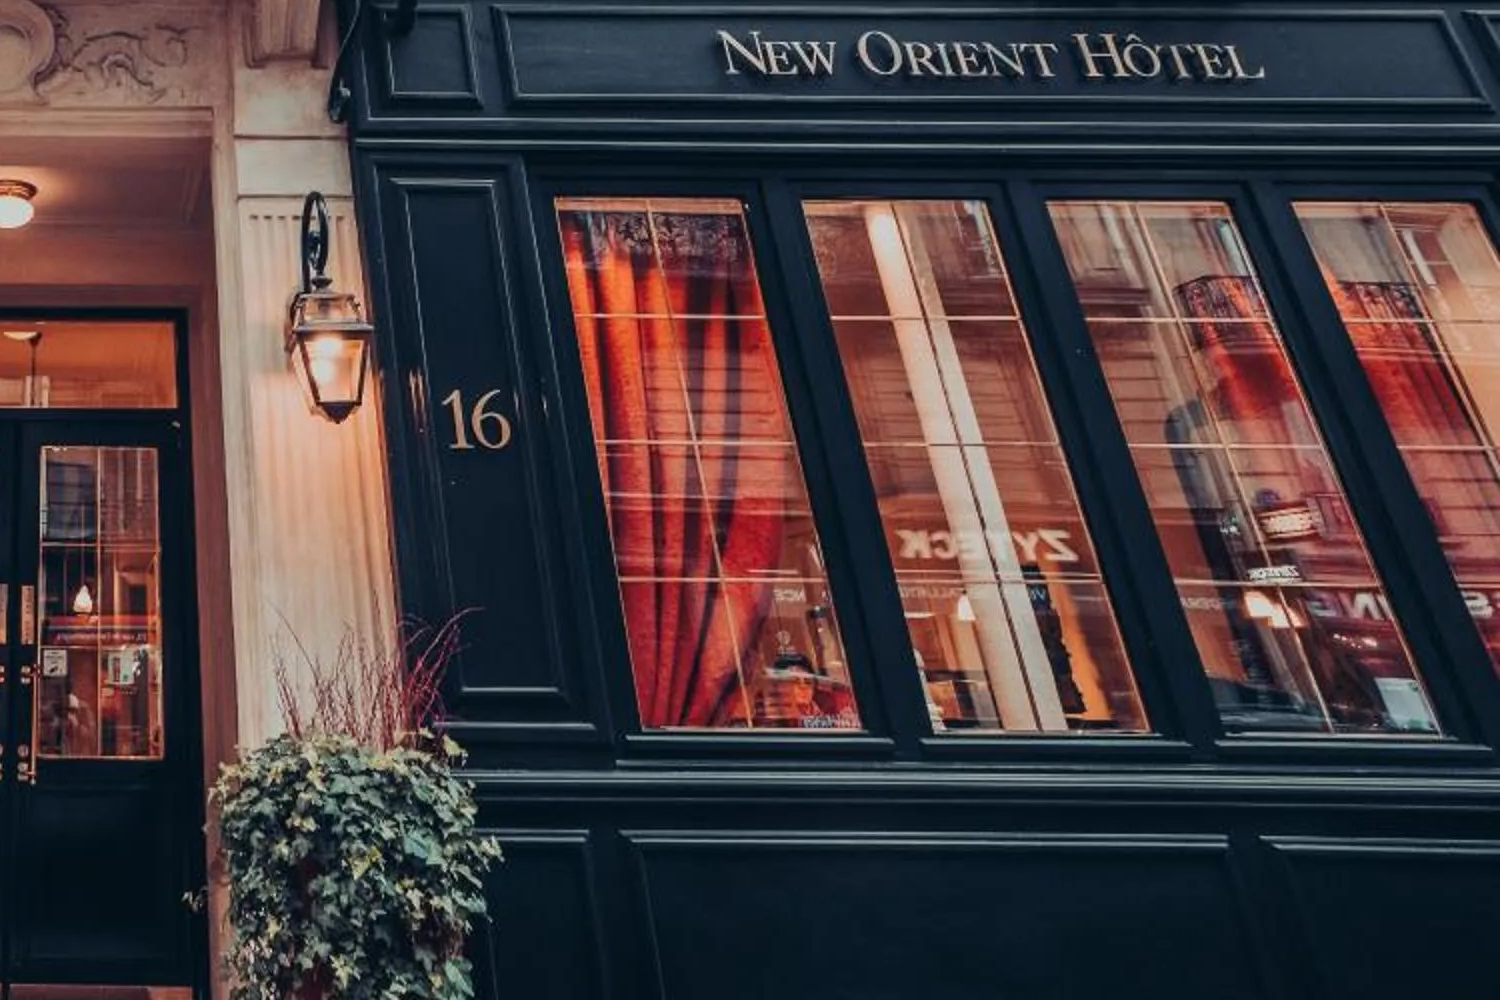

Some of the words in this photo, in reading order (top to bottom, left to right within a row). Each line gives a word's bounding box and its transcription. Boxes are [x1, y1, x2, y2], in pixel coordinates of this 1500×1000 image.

[717, 29, 837, 76] NEW
[856, 30, 1057, 78] ORIENT
[1071, 33, 1266, 80] HÔTEL
[441, 389, 511, 450] 16
